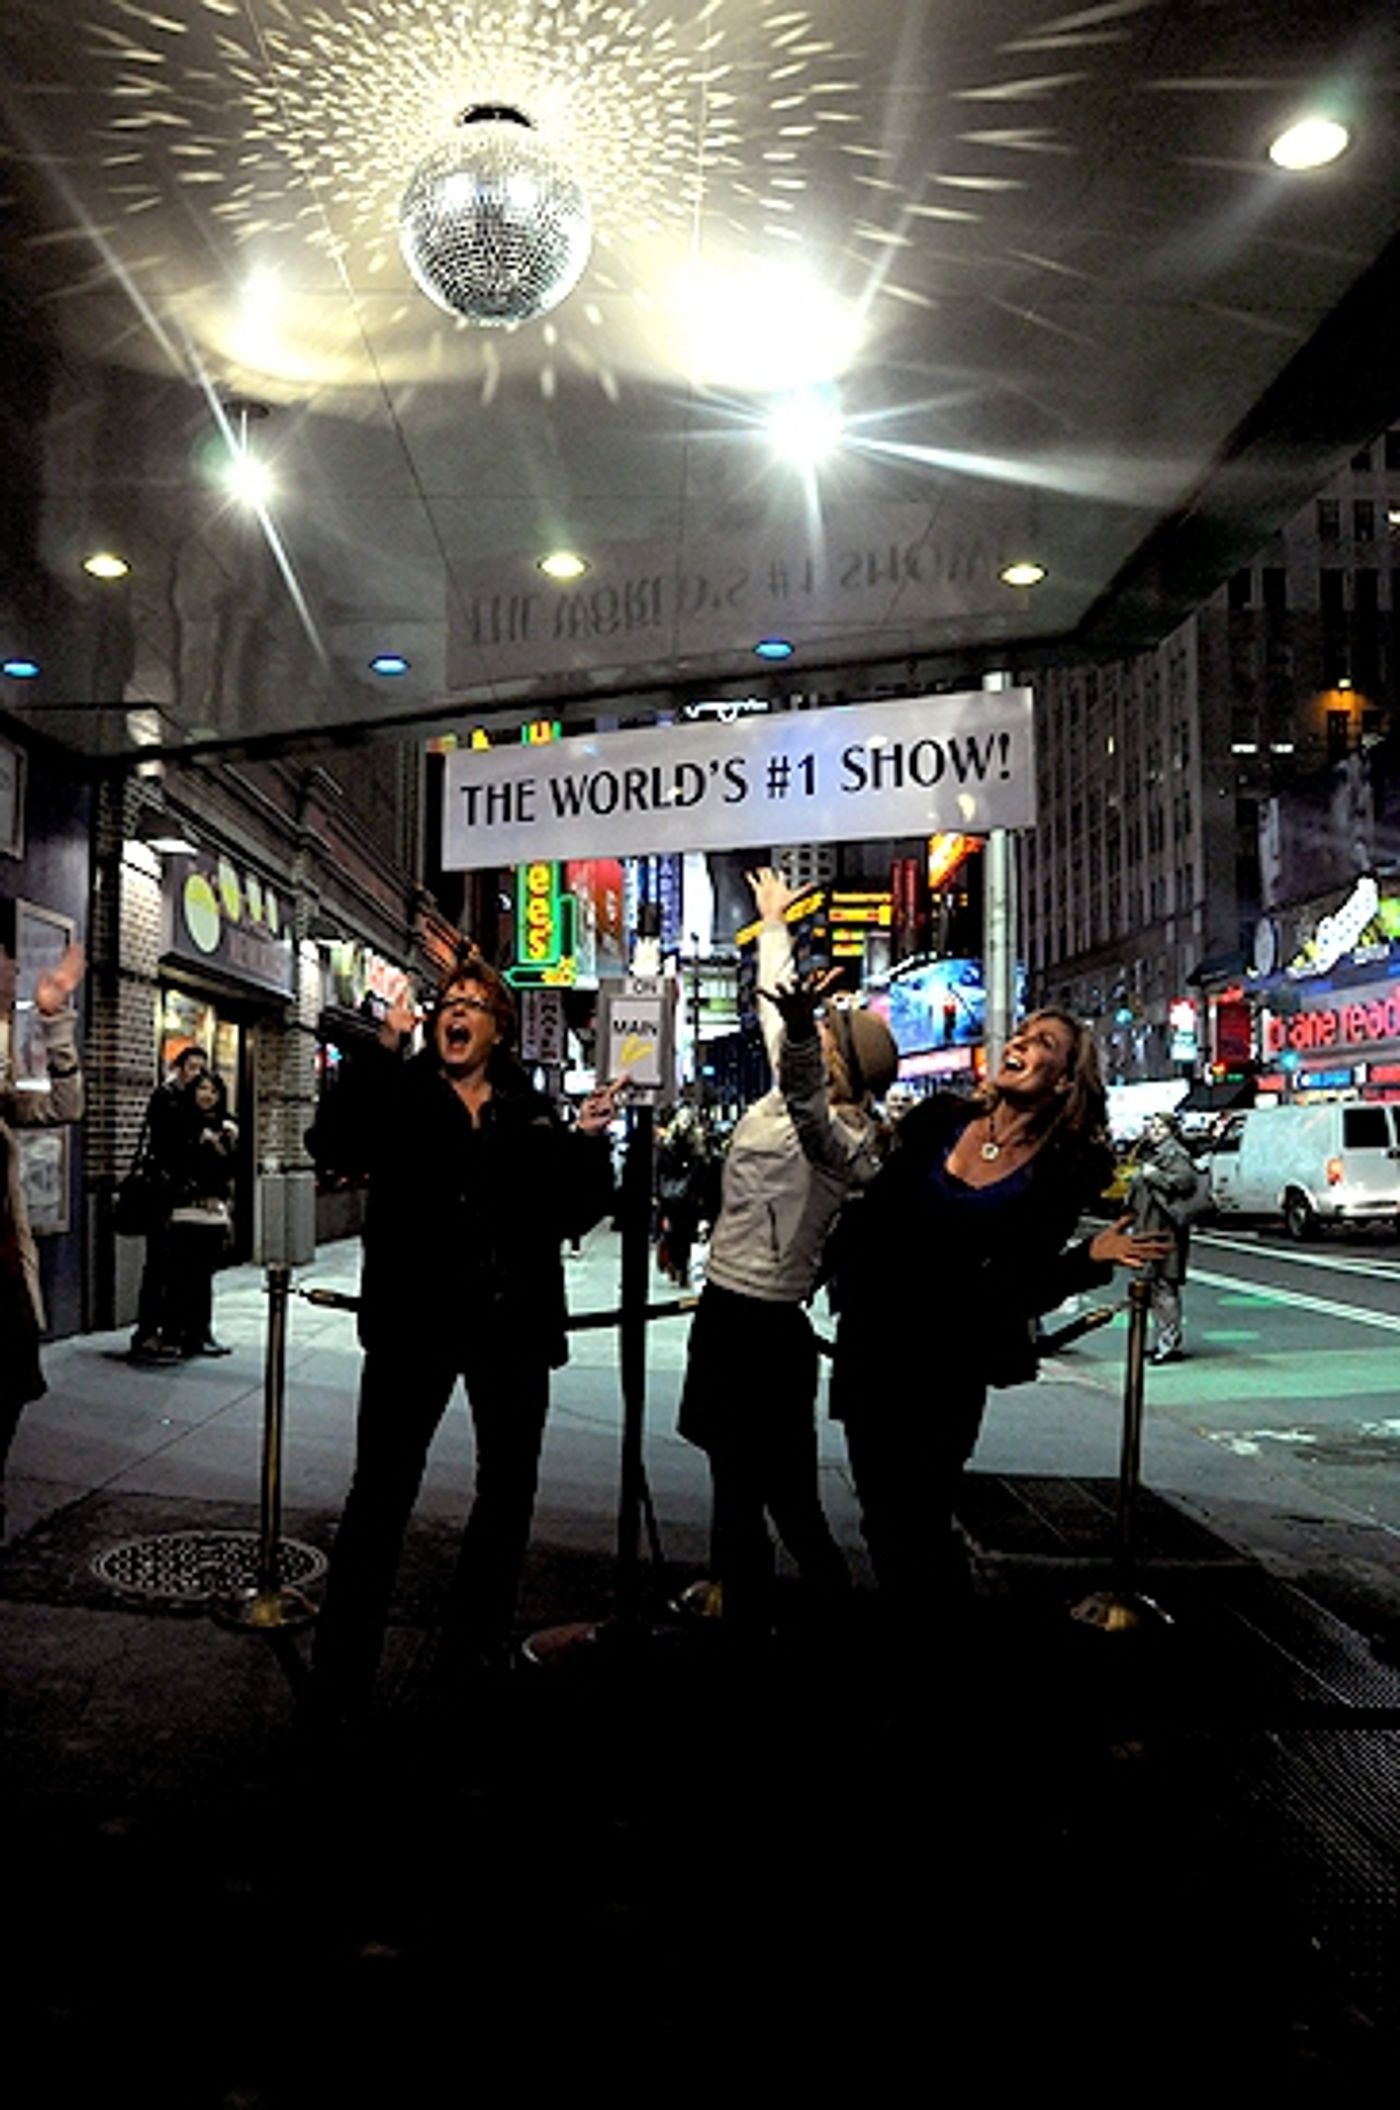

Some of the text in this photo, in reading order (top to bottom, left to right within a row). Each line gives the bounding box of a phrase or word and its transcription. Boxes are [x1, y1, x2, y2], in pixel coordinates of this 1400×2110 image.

[460, 732, 1011, 826] THE WORLD'S #1 SHOW!
[633, 977, 657, 994] ON
[613, 1018, 658, 1036] MAIN
[1268, 1009, 1337, 1053] dane
